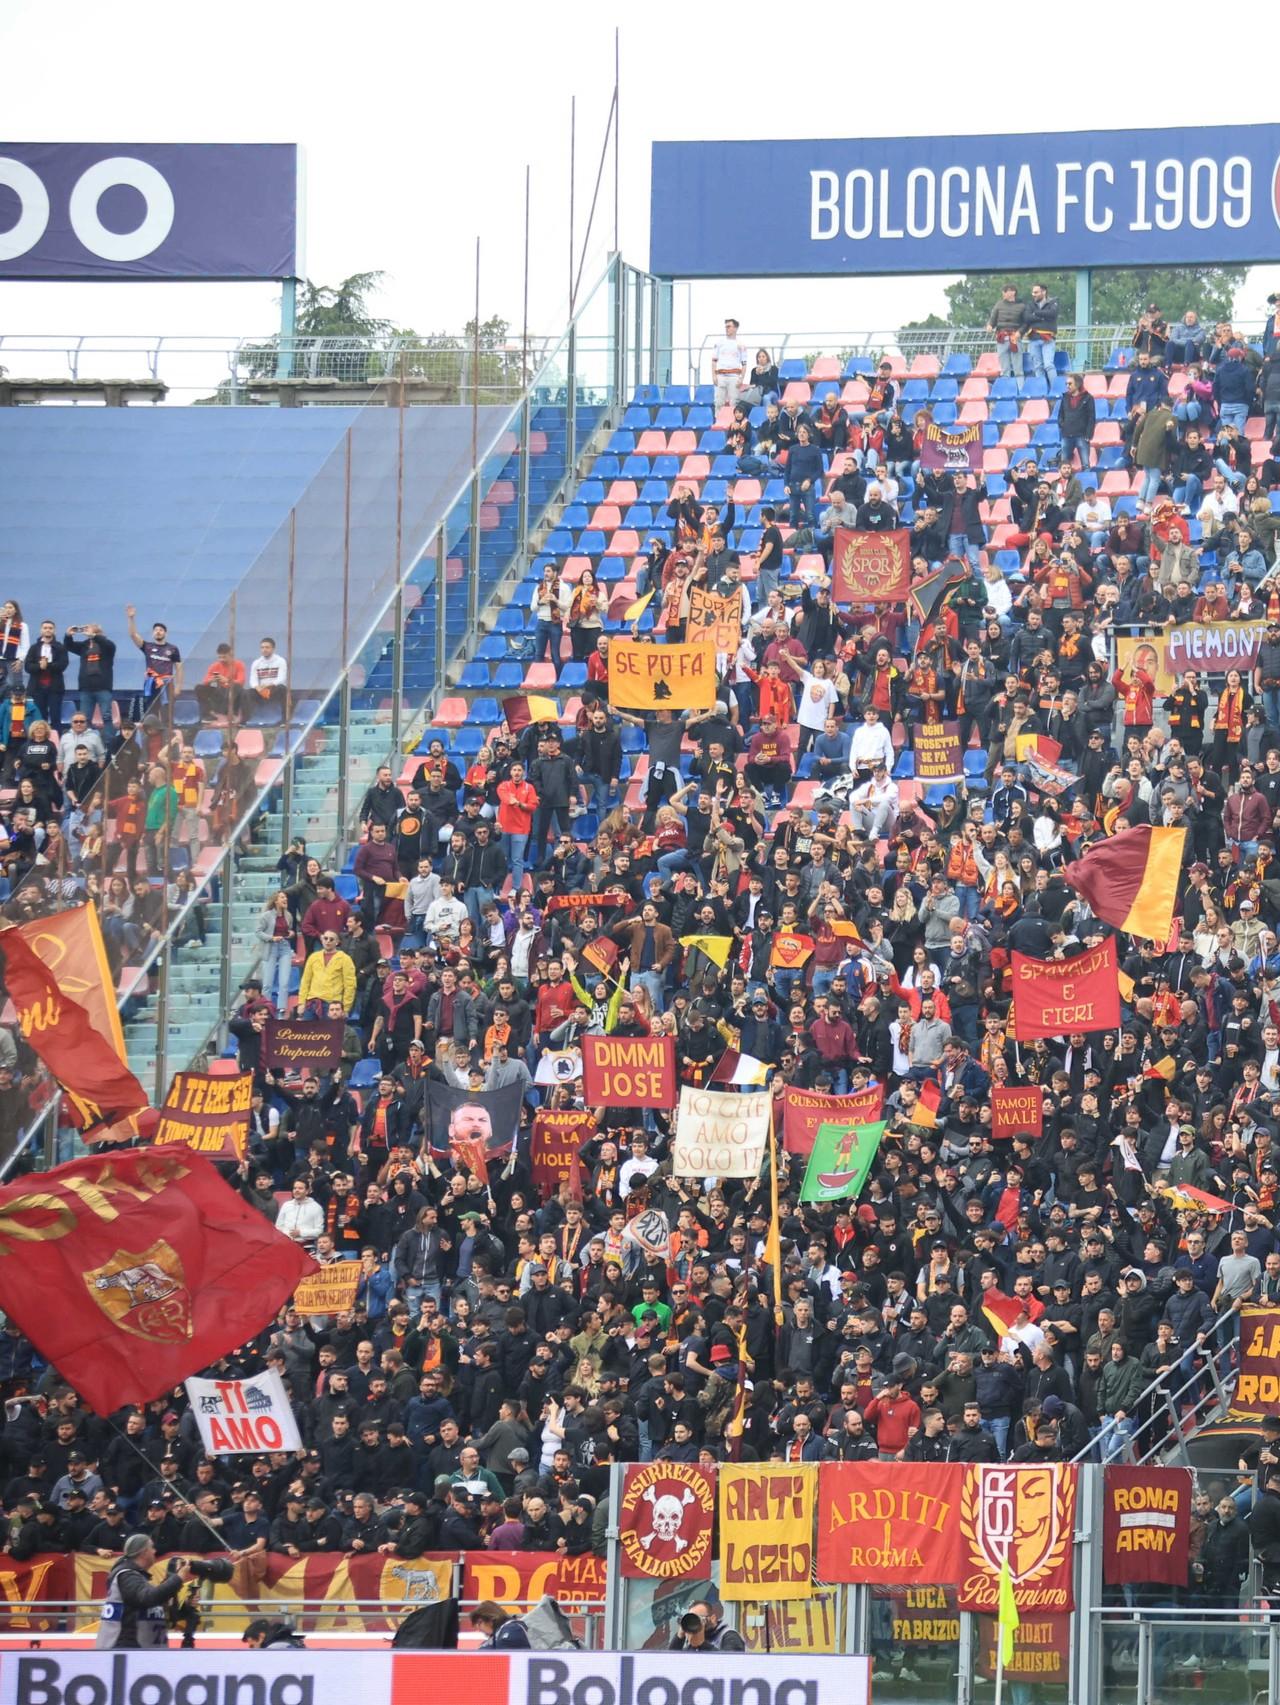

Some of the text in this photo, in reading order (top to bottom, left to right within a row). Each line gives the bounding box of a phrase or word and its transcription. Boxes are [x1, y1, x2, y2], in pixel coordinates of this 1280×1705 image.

[810, 156, 1251, 240] BOLOGNA FC 1909
[852, 557, 893, 576] SPQR
[1169, 626, 1268, 660] PIEMONT
[616, 652, 640, 675] SE
[922, 724, 944, 736] OGNI
[922, 751, 933, 763] SE
[1063, 984, 1075, 1001] E
[1042, 1002, 1094, 1026] FIERI
[275, 1027, 332, 1042] Pensiero
[274, 1045, 332, 1060] Stupendo
[594, 1041, 665, 1068] DIMMI
[167, 1075, 182, 1108] A
[182, 1078, 208, 1113] TE
[789, 1093, 878, 1108] QUESTA MAGLIA
[996, 1096, 1037, 1110] FAMOJE
[998, 1110, 1038, 1125] MALE
[544, 1132, 580, 1144] E LA
[695, 1121, 748, 1145] AMO
[677, 1146, 732, 1171] SOLO
[215, 1381, 248, 1414] TI
[210, 1415, 282, 1450] AMO
[622, 1463, 714, 1513] INSURREZIONE
[1114, 1486, 1179, 1512] ROMA
[829, 1489, 950, 1534] ARDITI
[984, 1471, 1015, 1560] ASR
[621, 1527, 712, 1577] GIALLOROSSA
[1116, 1528, 1176, 1554] ARMY
[850, 1547, 925, 1567] ROMA
[906, 1587, 947, 1609] LUCA
[893, 1619, 960, 1641] FABRIZIO
[17, 1654, 314, 1705] Bologna
[528, 1655, 818, 1705] Bologna
